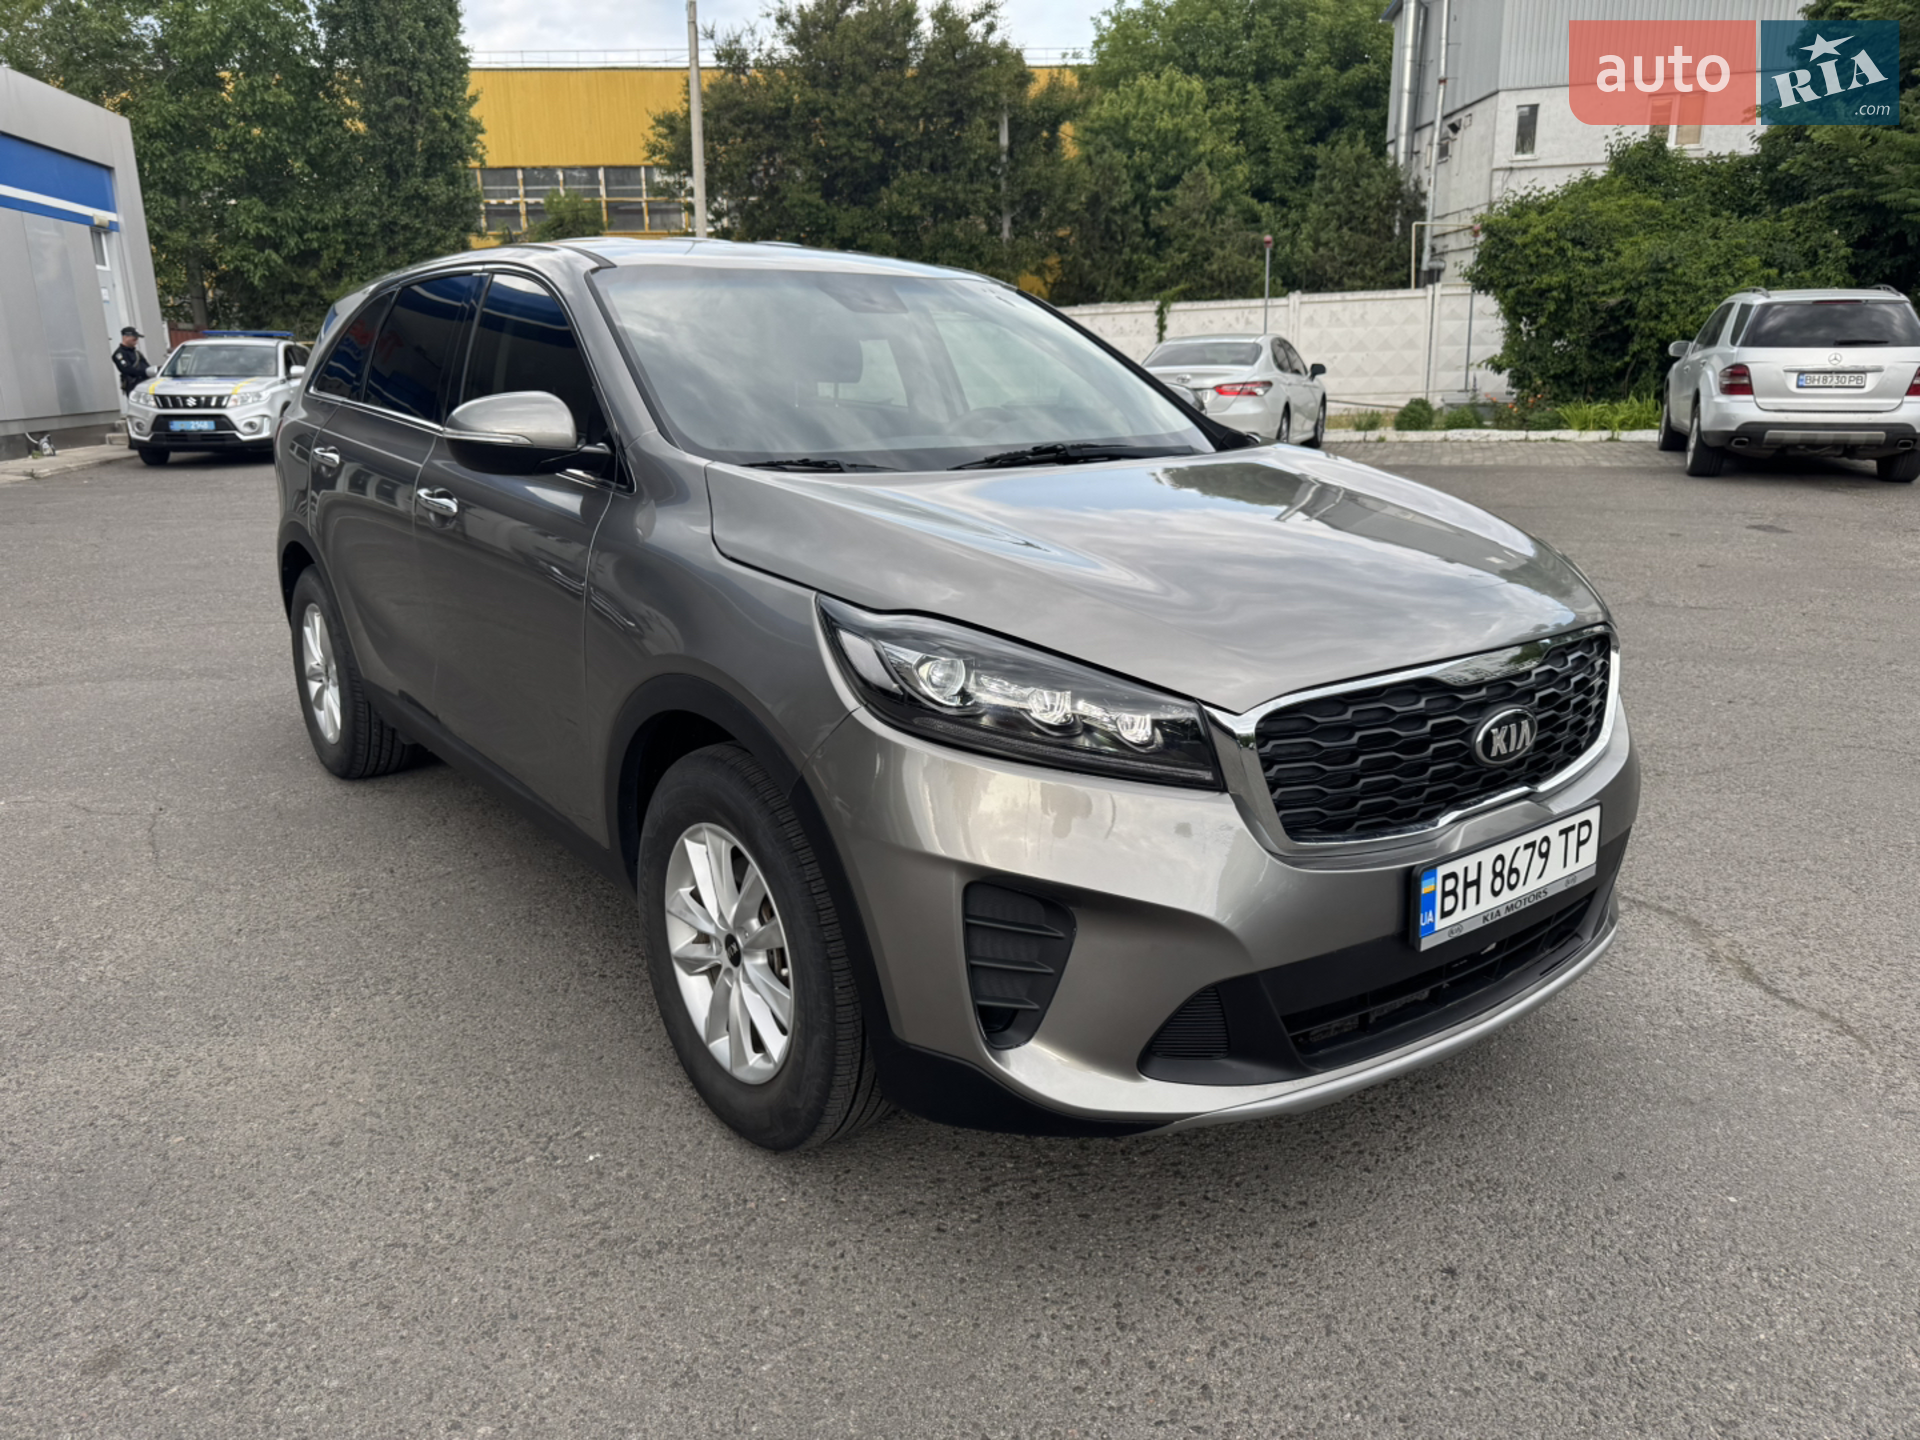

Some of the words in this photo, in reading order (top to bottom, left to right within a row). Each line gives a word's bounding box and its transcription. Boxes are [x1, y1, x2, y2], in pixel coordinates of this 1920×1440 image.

[1805, 375, 1820, 385] BH
[1822, 375, 1847, 385] 8730
[1490, 719, 1531, 757] KIA
[1440, 861, 1482, 920] BH
[1490, 835, 1551, 898] 8679
[1558, 819, 1593, 869] TP
[1420, 910, 1435, 927] UA
[1482, 909, 1501, 924] KIA
[1504, 888, 1549, 915] MOTORS
